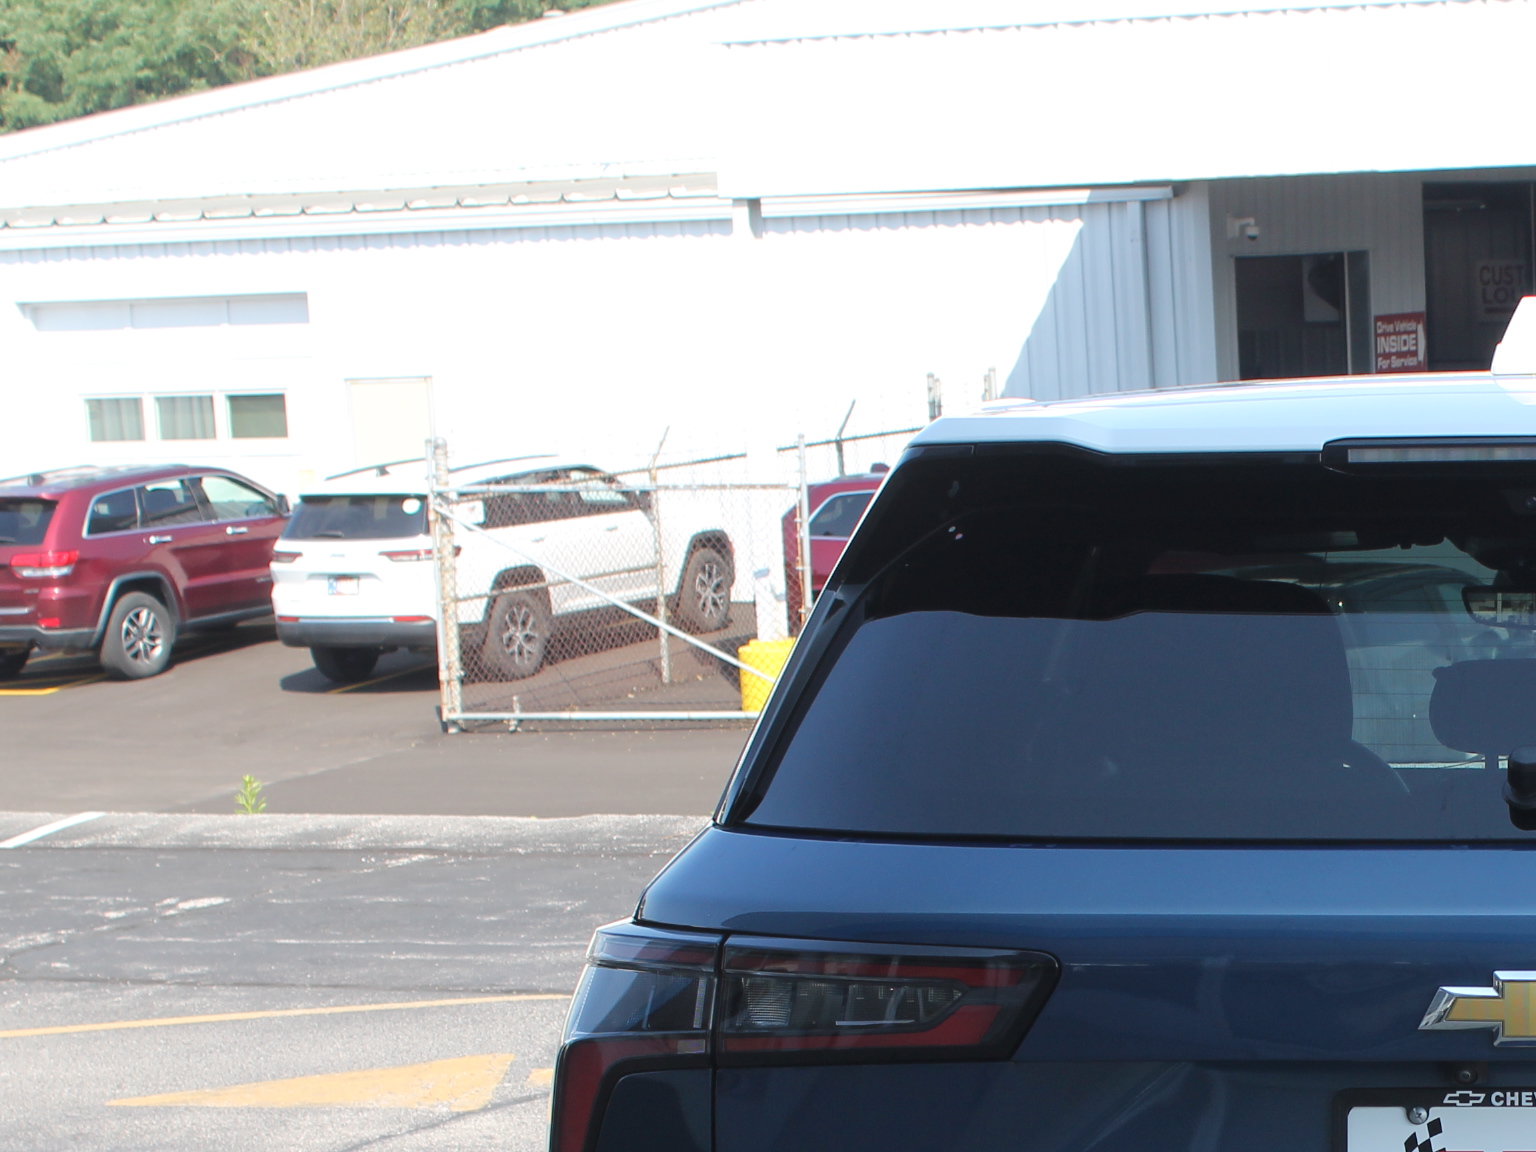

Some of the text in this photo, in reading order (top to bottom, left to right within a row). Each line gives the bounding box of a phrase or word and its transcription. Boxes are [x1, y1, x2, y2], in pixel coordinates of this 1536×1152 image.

[1376, 319, 1417, 333] Drive Vehicle
[1376, 334, 1417, 354] INSIDE
[1377, 355, 1418, 369] For Service
